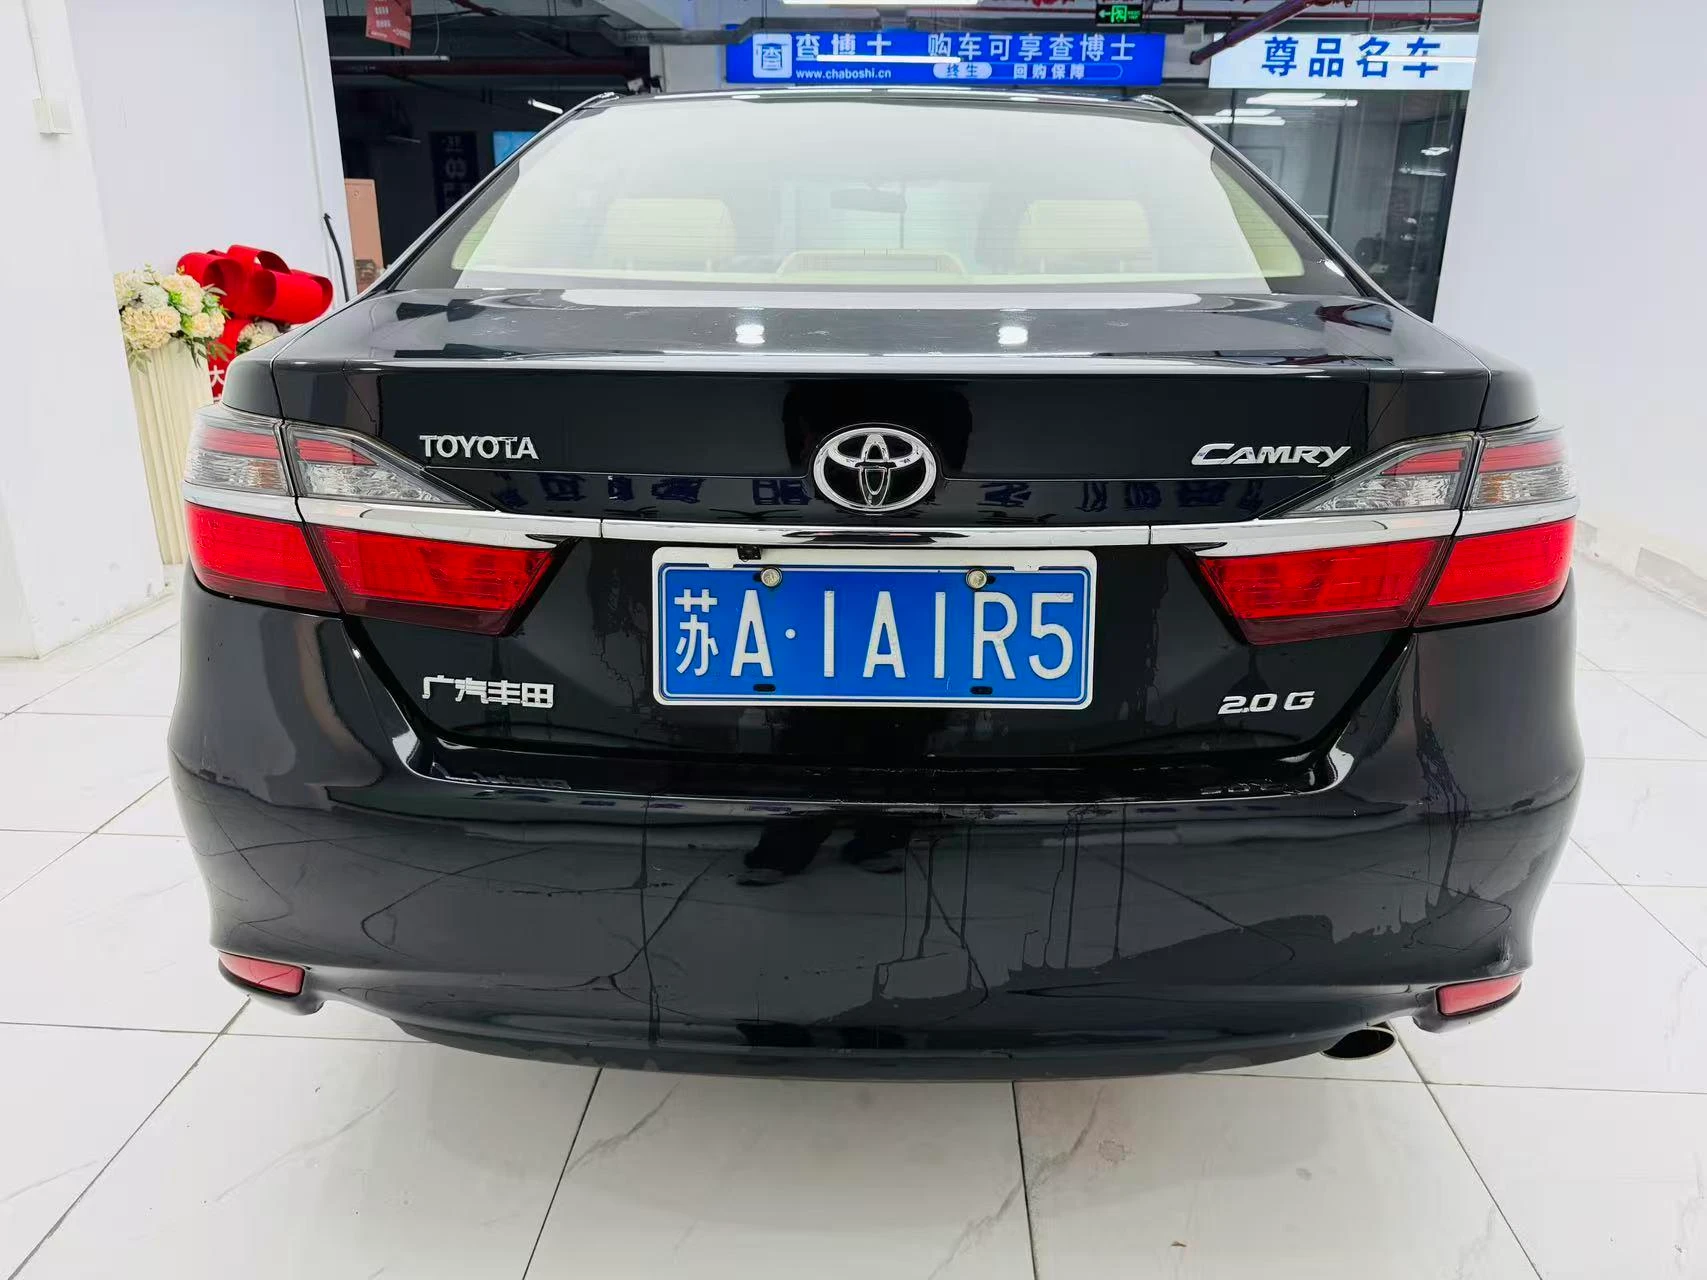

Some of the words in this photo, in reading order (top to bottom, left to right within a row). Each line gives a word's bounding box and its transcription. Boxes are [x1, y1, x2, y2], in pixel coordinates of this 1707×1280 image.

[795, 33, 892, 61] 查博士
[927, 32, 1136, 62] 购车可享查博士
[1261, 36, 1441, 78] 尊品名车
[795, 67, 892, 80] www.chaboshi.cn
[1013, 63, 1085, 80] 回购保障
[419, 434, 539, 461] TOYOTA
[1191, 443, 1351, 467] CAMRY
[422, 674, 555, 709] 广汽丰田
[1217, 693, 1278, 715] 2.0
[1283, 690, 1316, 712] G
